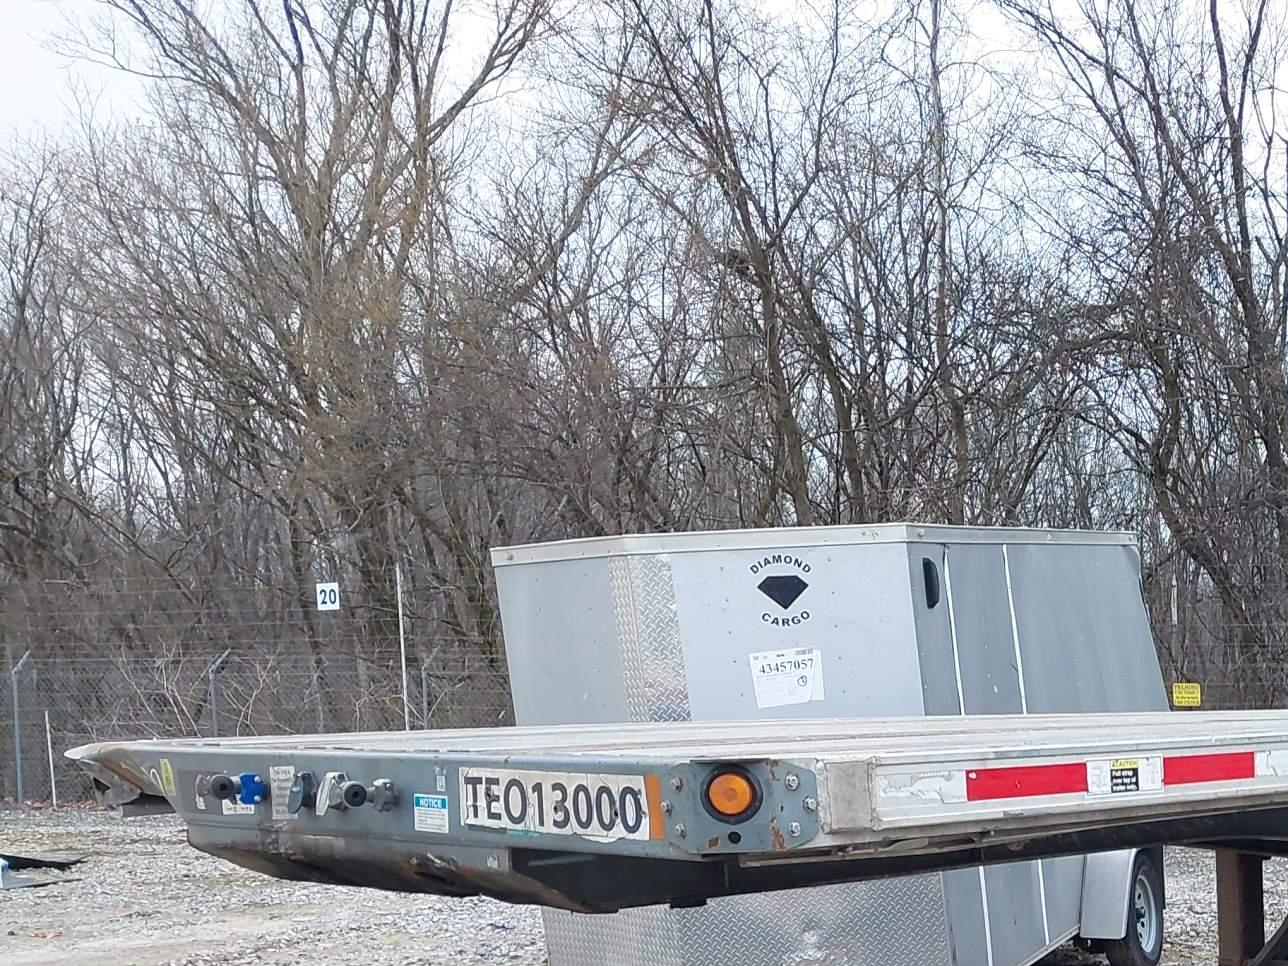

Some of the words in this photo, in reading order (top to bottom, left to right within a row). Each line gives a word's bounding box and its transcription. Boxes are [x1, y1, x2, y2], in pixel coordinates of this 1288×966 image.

[750, 554, 812, 574] DIAMOND
[319, 588, 337, 605] 20
[761, 610, 810, 627] CARGO
[759, 658, 814, 674] 43457057
[419, 797, 443, 809] NOTICE
[463, 776, 643, 834] TEO13000
